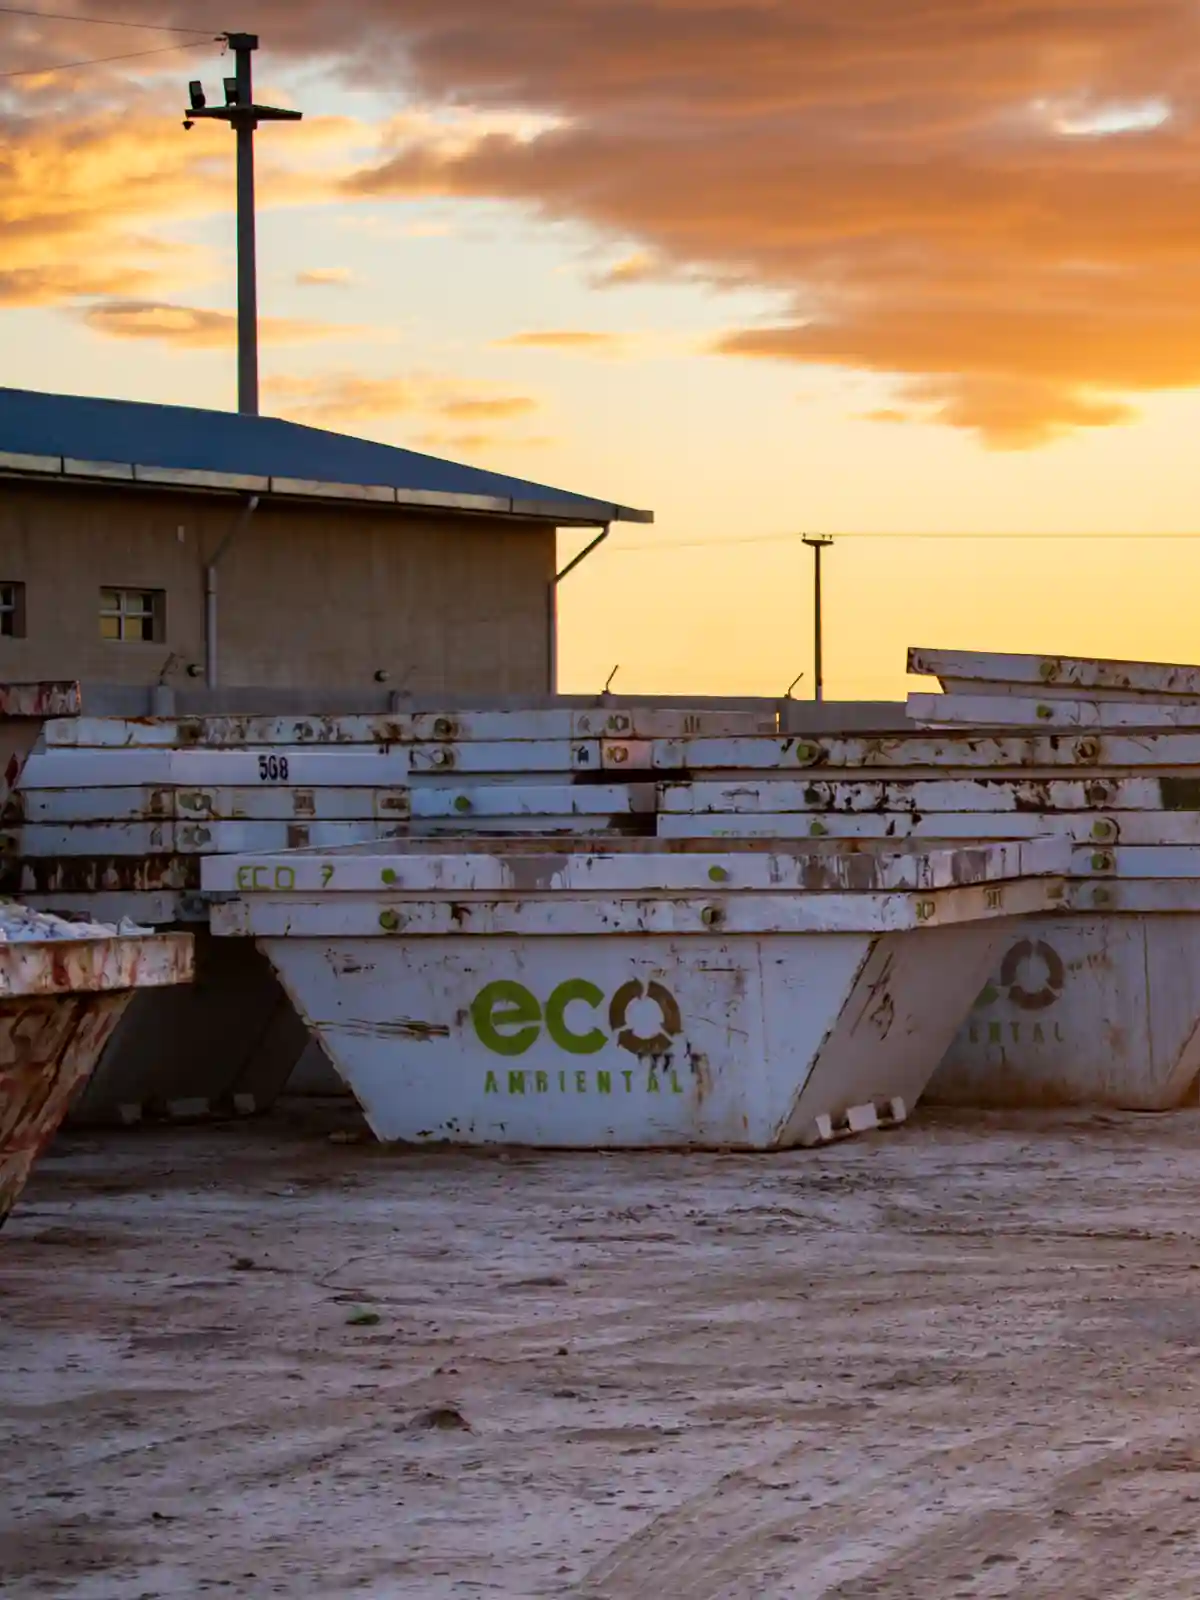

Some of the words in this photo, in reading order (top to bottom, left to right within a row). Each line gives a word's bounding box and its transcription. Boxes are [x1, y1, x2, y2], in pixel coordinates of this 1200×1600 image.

[236, 865, 295, 891] ECO
[470, 977, 682, 1056] eco
[484, 1070, 683, 1094] AMBIENTAL
